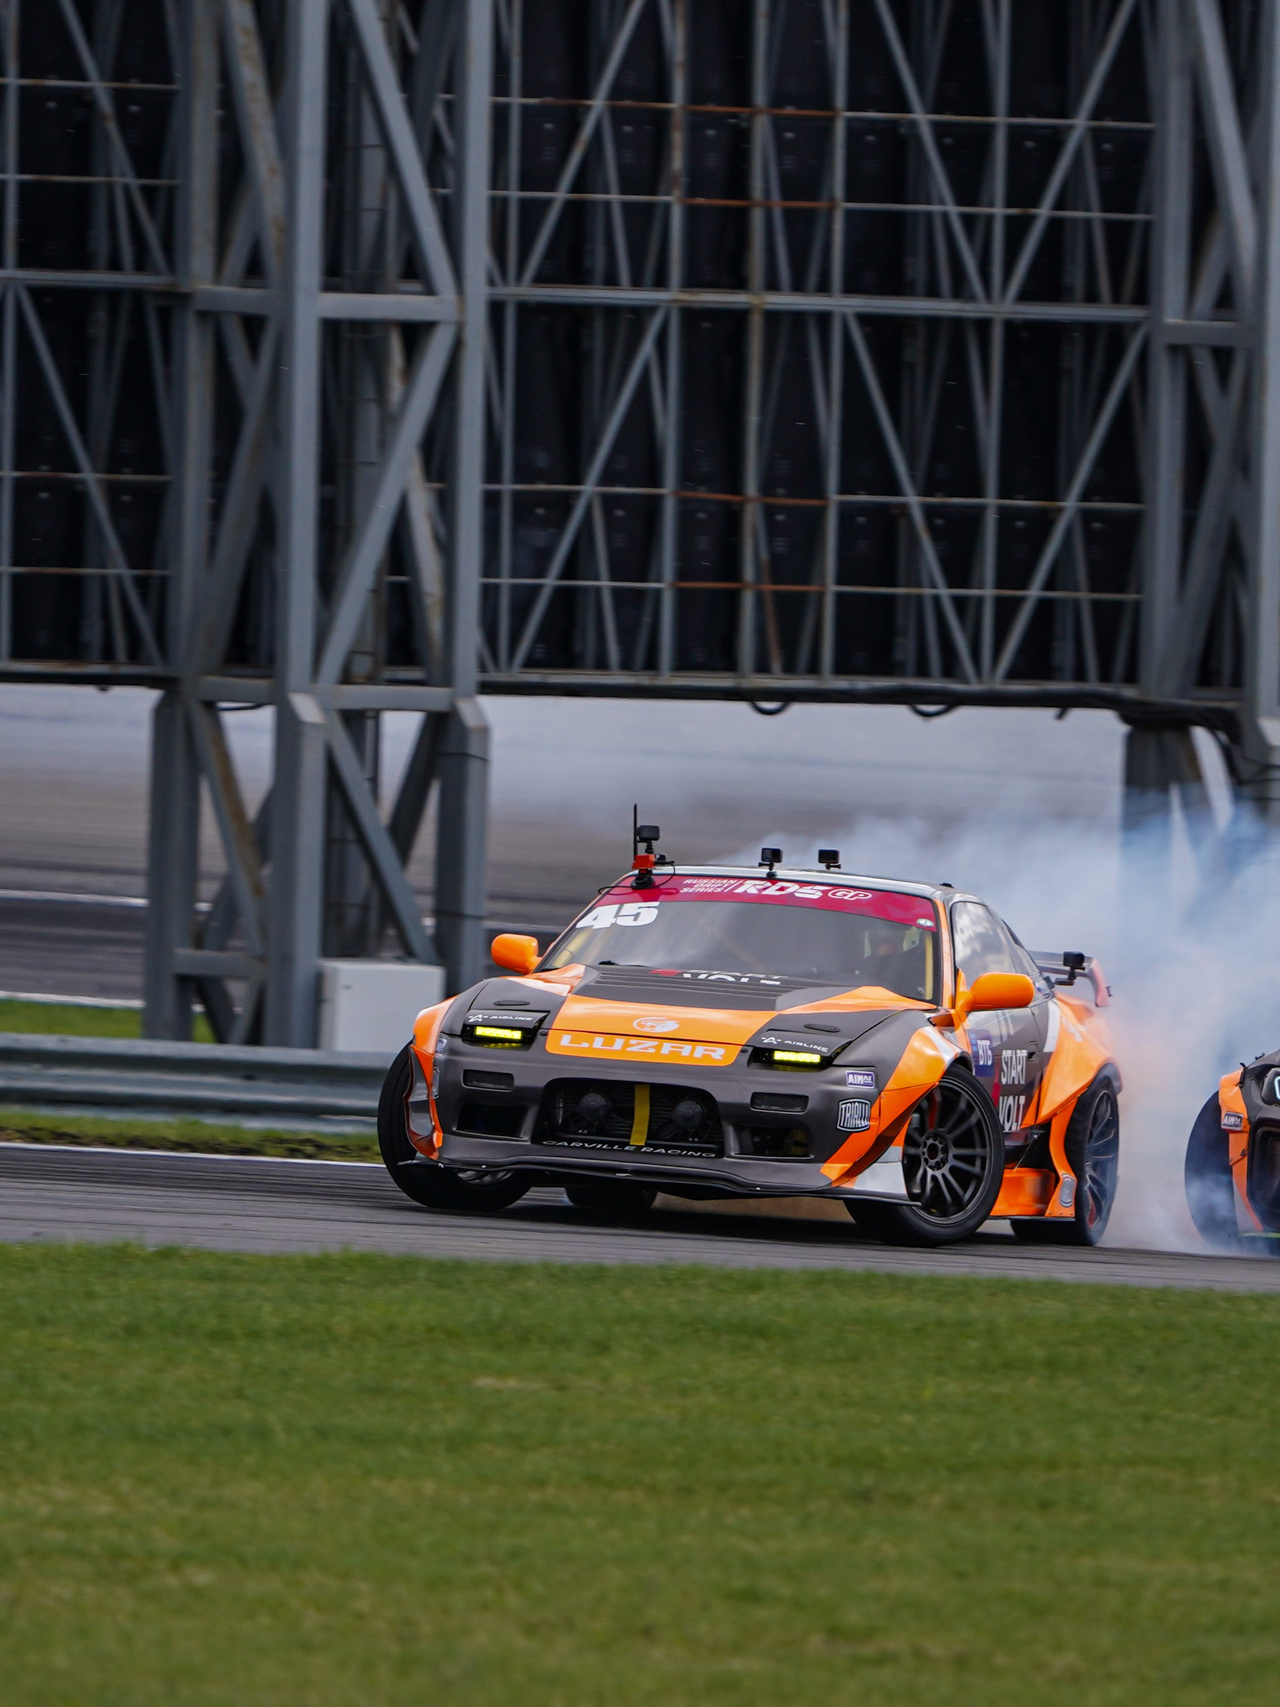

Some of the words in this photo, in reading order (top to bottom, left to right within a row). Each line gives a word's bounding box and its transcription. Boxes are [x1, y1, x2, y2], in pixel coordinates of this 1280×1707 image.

[733, 880, 833, 899] RDS
[828, 889, 872, 900] GP
[575, 901, 660, 930] 45
[559, 1034, 725, 1060] LUZAR
[784, 1040, 829, 1053] AIRLINE
[1001, 1050, 1028, 1085] START
[542, 1140, 637, 1151] CARVILLE
[641, 1147, 717, 1158] RACING
